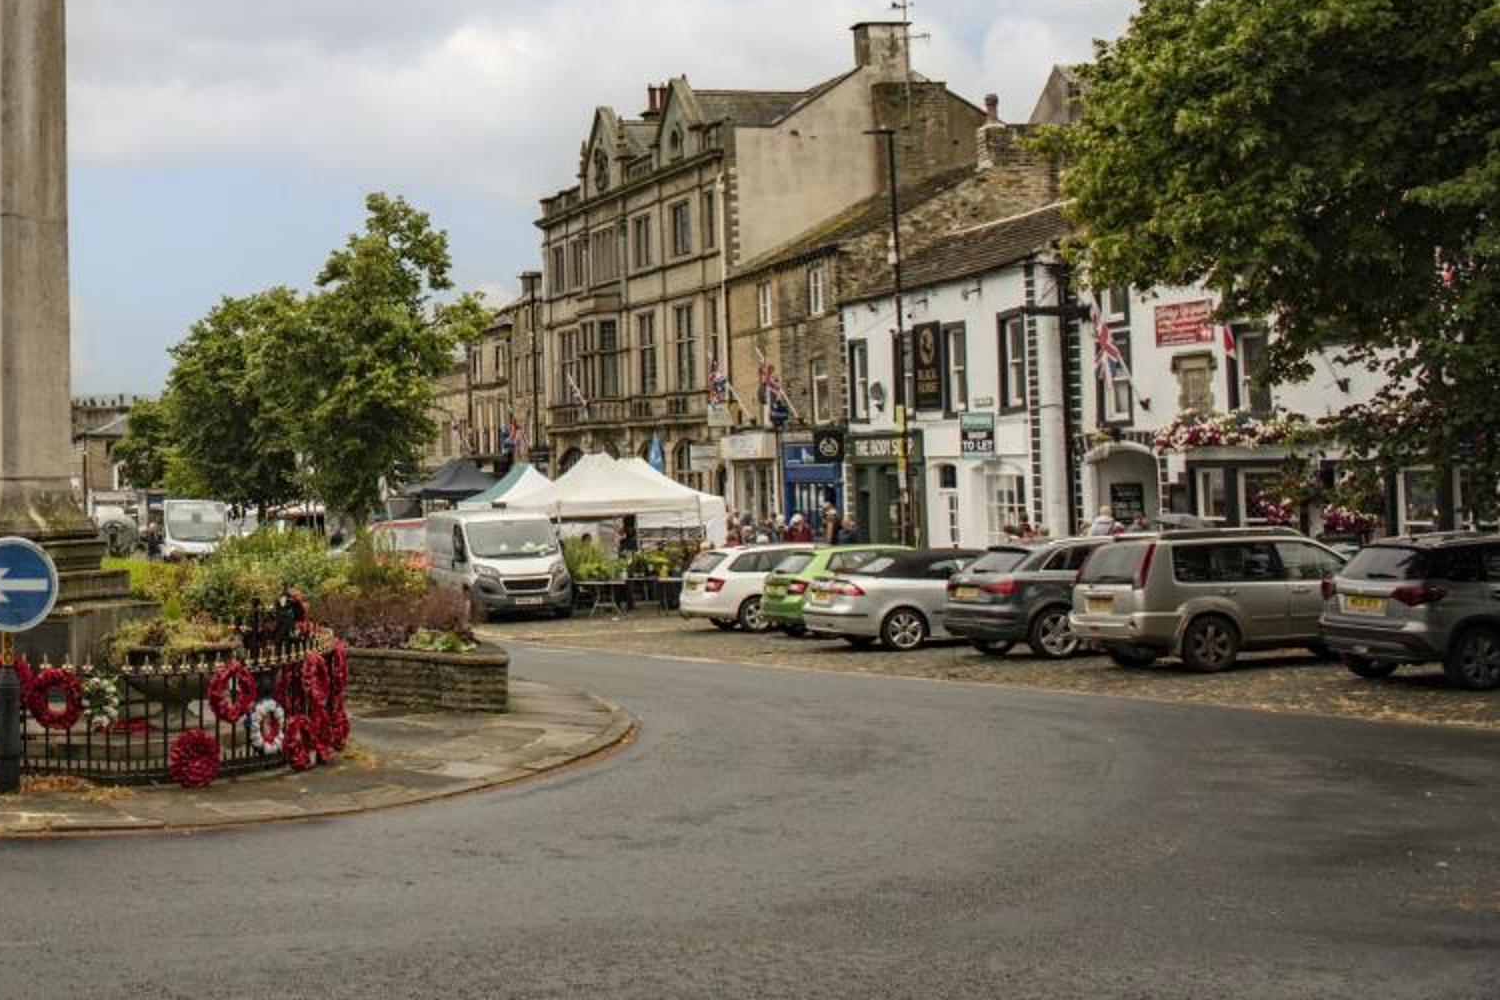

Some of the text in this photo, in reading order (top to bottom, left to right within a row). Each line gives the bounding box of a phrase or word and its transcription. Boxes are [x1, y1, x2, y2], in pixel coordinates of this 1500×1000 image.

[855, 440, 869, 456] THE
[963, 440, 993, 451] TO LET
